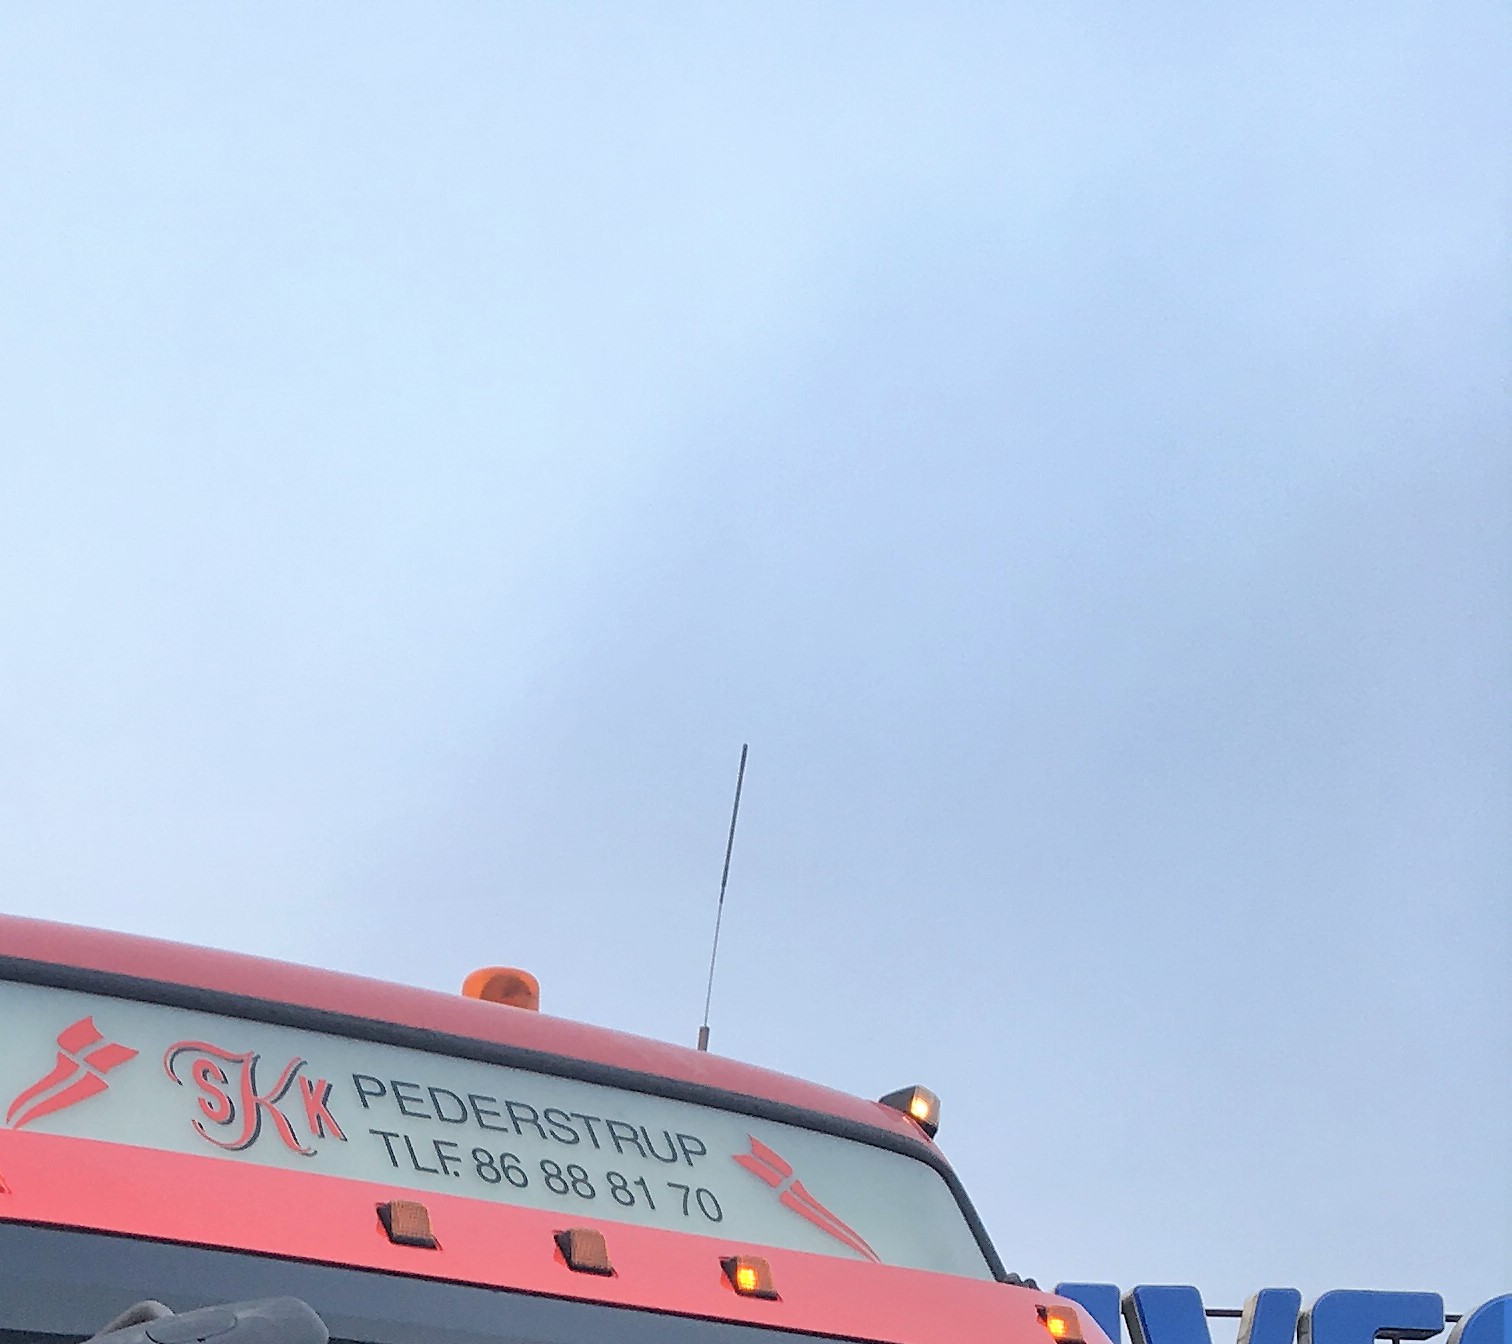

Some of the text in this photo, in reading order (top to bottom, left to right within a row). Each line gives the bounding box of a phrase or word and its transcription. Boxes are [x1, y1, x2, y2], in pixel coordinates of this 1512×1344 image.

[352, 1073, 707, 1167] PEDERSTRUP
[471, 1147, 529, 1189] 86
[539, 1159, 596, 1200] 88
[606, 1171, 656, 1210] 81
[667, 1182, 723, 1222] 70
